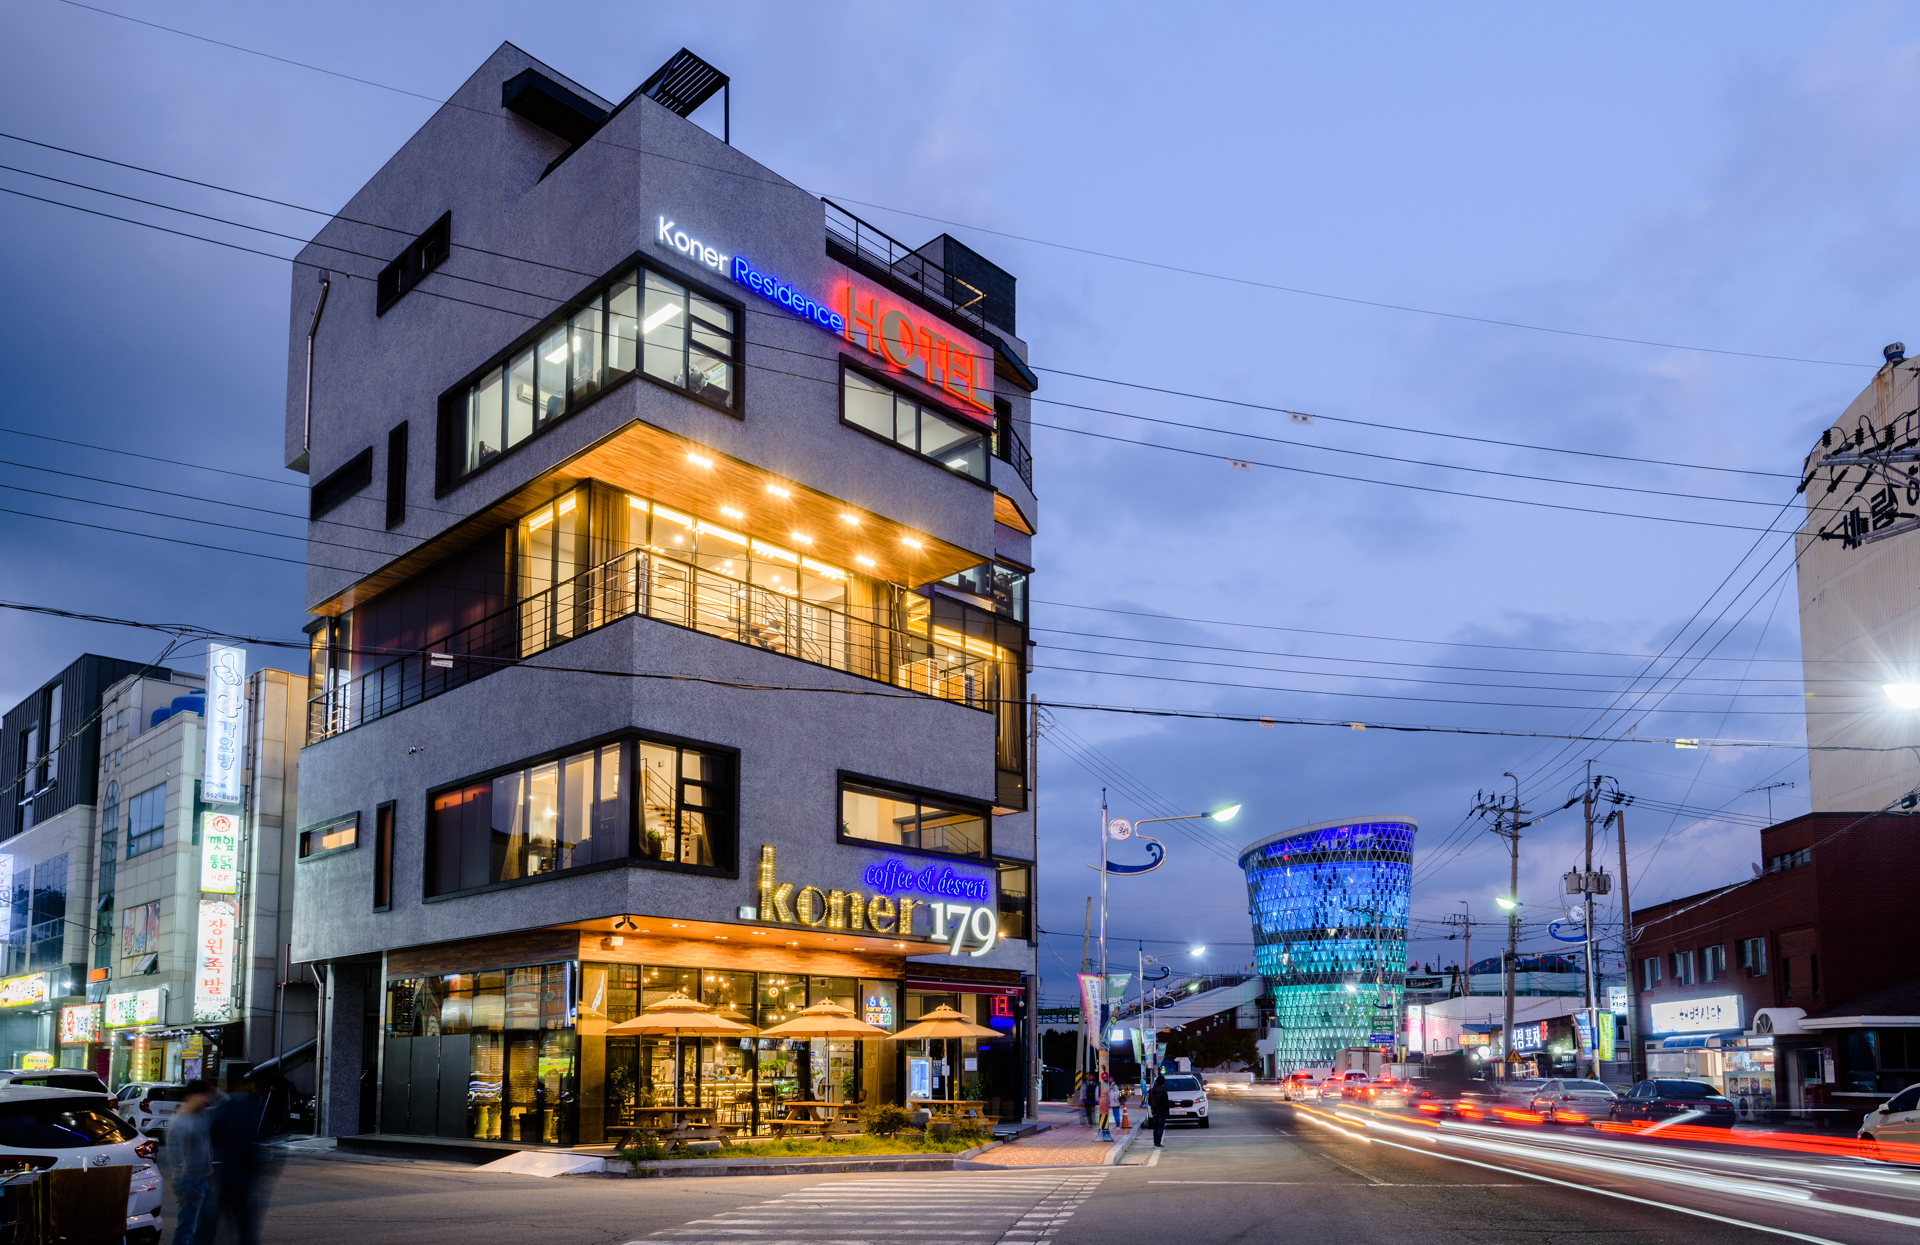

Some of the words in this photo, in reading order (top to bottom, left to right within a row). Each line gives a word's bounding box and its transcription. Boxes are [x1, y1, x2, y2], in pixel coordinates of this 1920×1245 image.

[658, 215, 728, 271] Koner
[734, 256, 844, 332] Residence
[845, 286, 994, 412] HOTEL
[212, 690, 242, 719] 왕
[217, 720, 237, 770] 가요방
[209, 855, 233, 870] 통닭
[866, 859, 914, 892] coffee
[917, 865, 935, 893] &
[938, 868, 989, 900] dessert
[760, 844, 924, 935] koner
[929, 902, 997, 957] 179
[204, 917, 227, 995] 장원족발
[867, 1014, 890, 1024] OPEN
[1679, 1004, 1721, 1025] 해변식당
